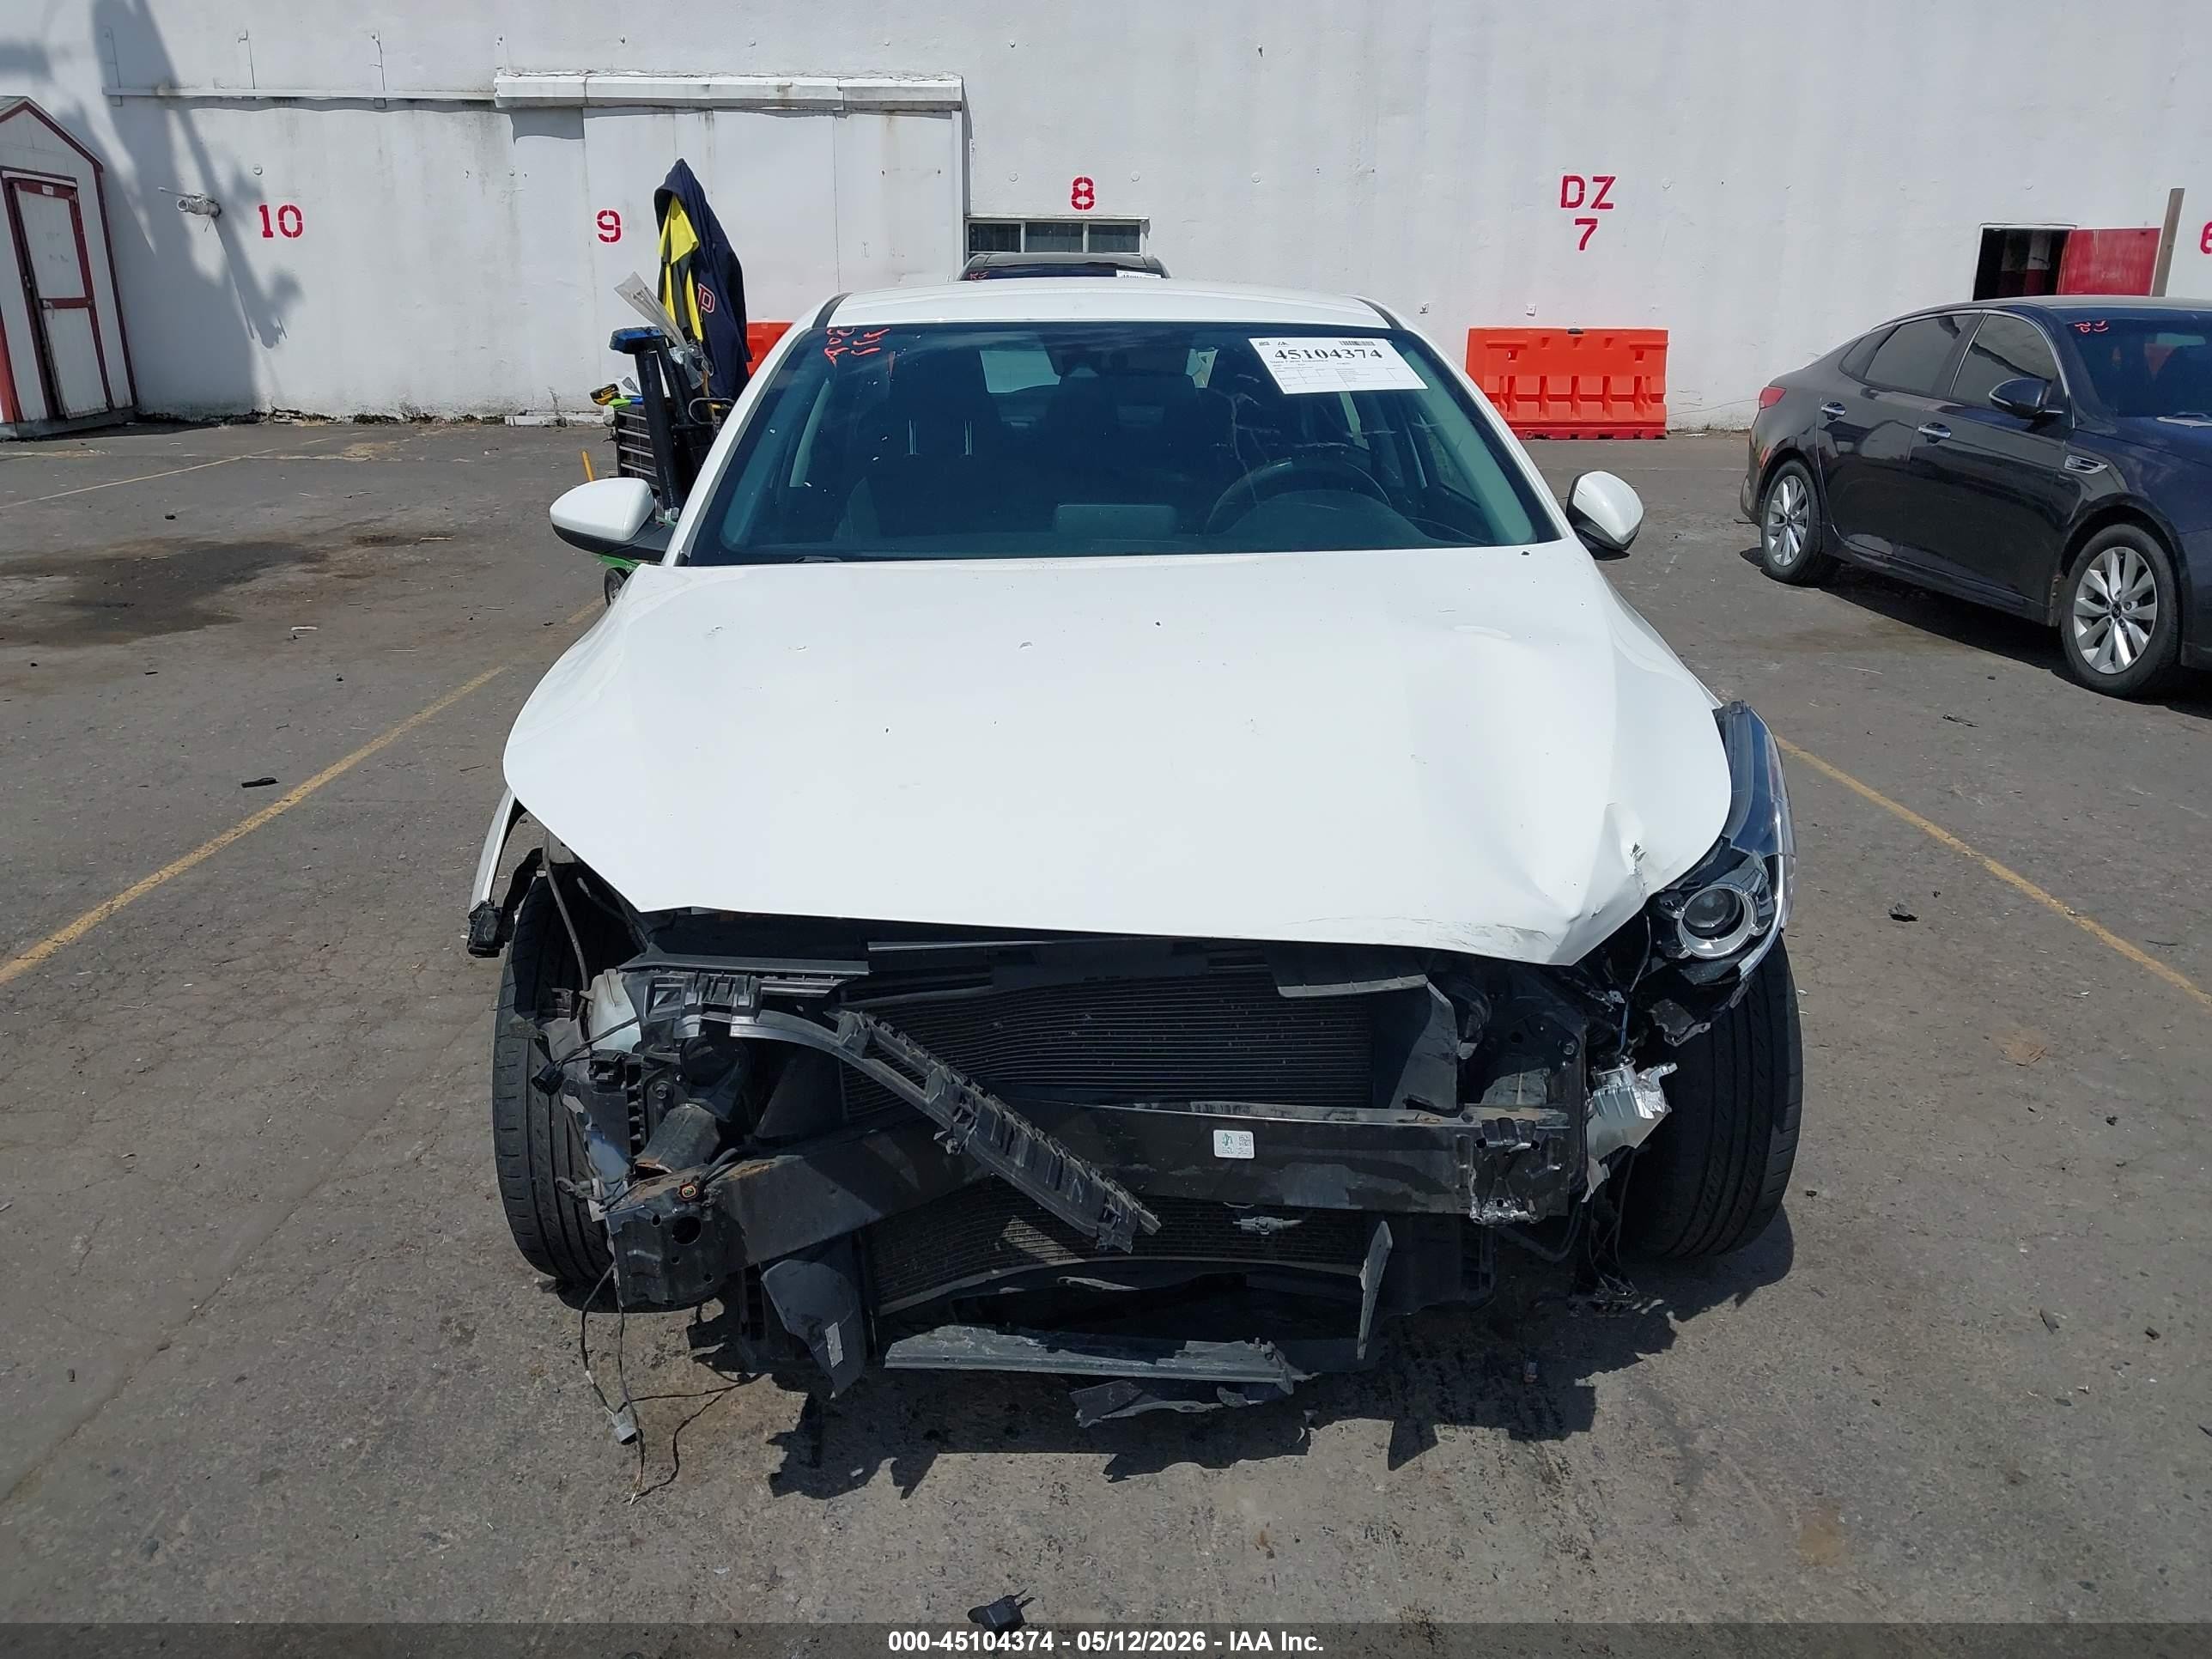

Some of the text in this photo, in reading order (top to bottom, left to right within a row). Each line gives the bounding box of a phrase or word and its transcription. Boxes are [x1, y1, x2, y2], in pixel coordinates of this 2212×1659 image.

[1071, 177, 1095, 211] 8
[1559, 174, 1615, 211] DZ
[258, 204, 303, 239] 10
[597, 210, 623, 244] 9
[1574, 217, 1598, 252] 7
[1274, 349, 1383, 360] 45104374
